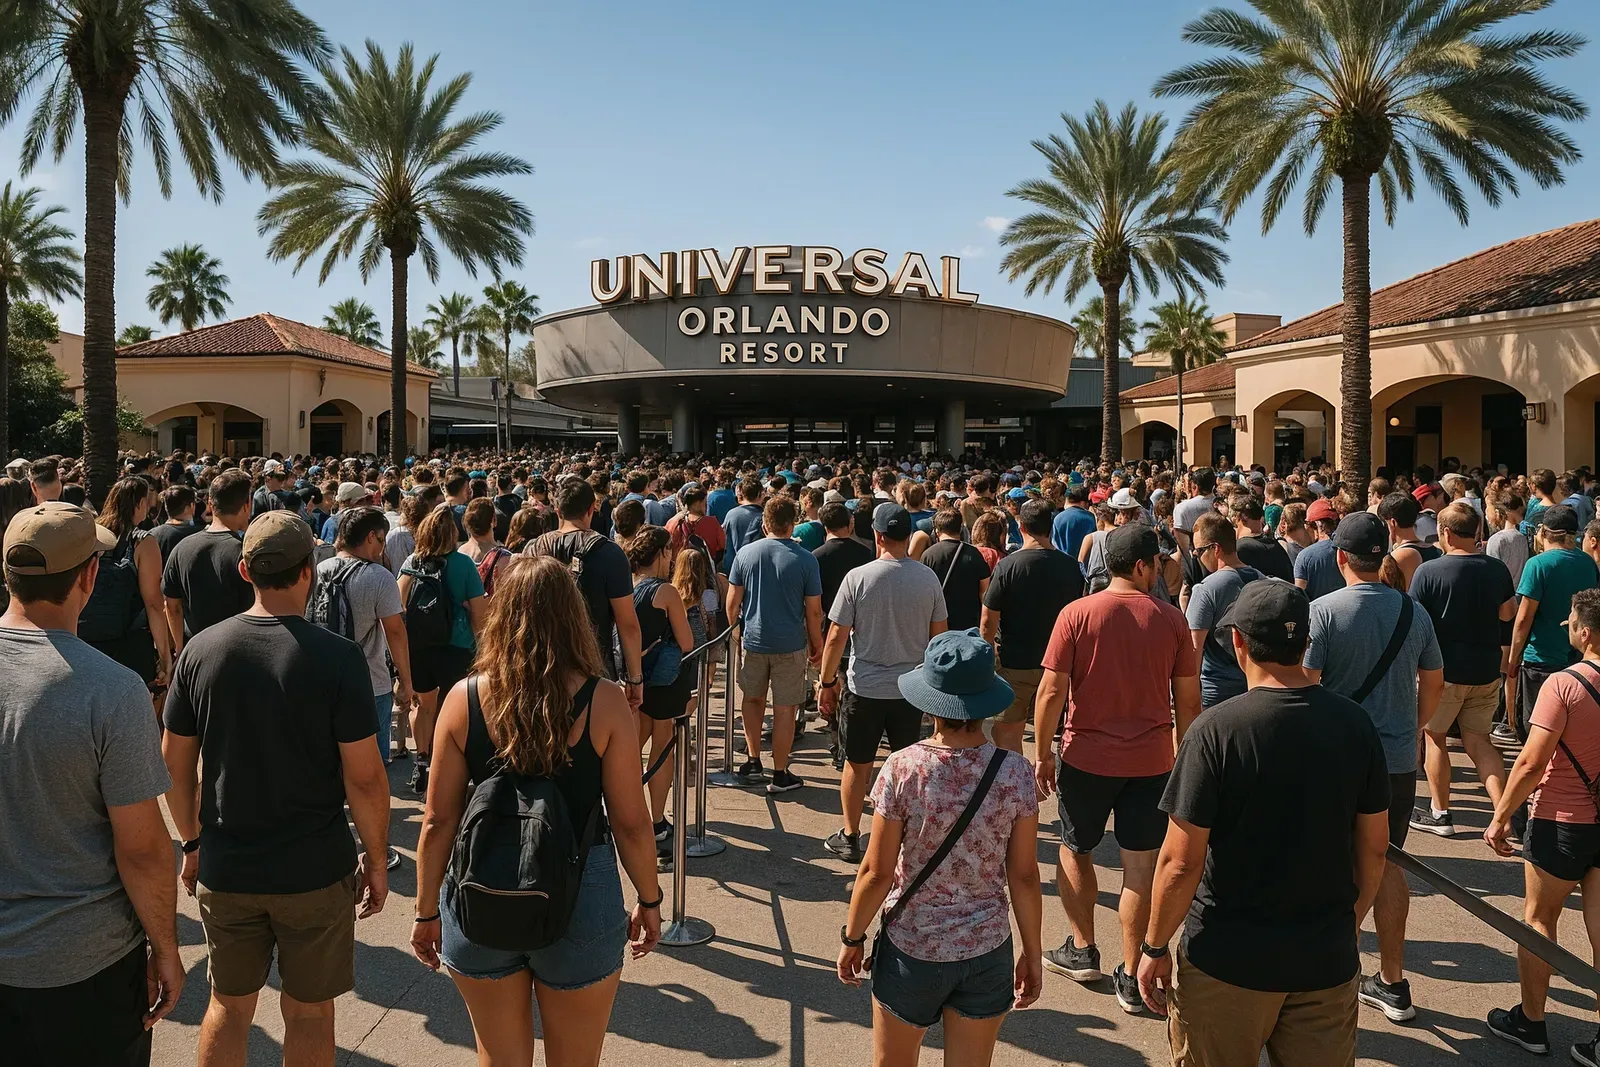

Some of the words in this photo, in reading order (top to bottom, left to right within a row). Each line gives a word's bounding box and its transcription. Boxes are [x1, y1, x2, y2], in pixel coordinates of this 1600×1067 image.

[591, 245, 979, 304] UNIVERSAL
[678, 305, 890, 336] ORLANDO
[720, 342, 848, 363] RESORT
